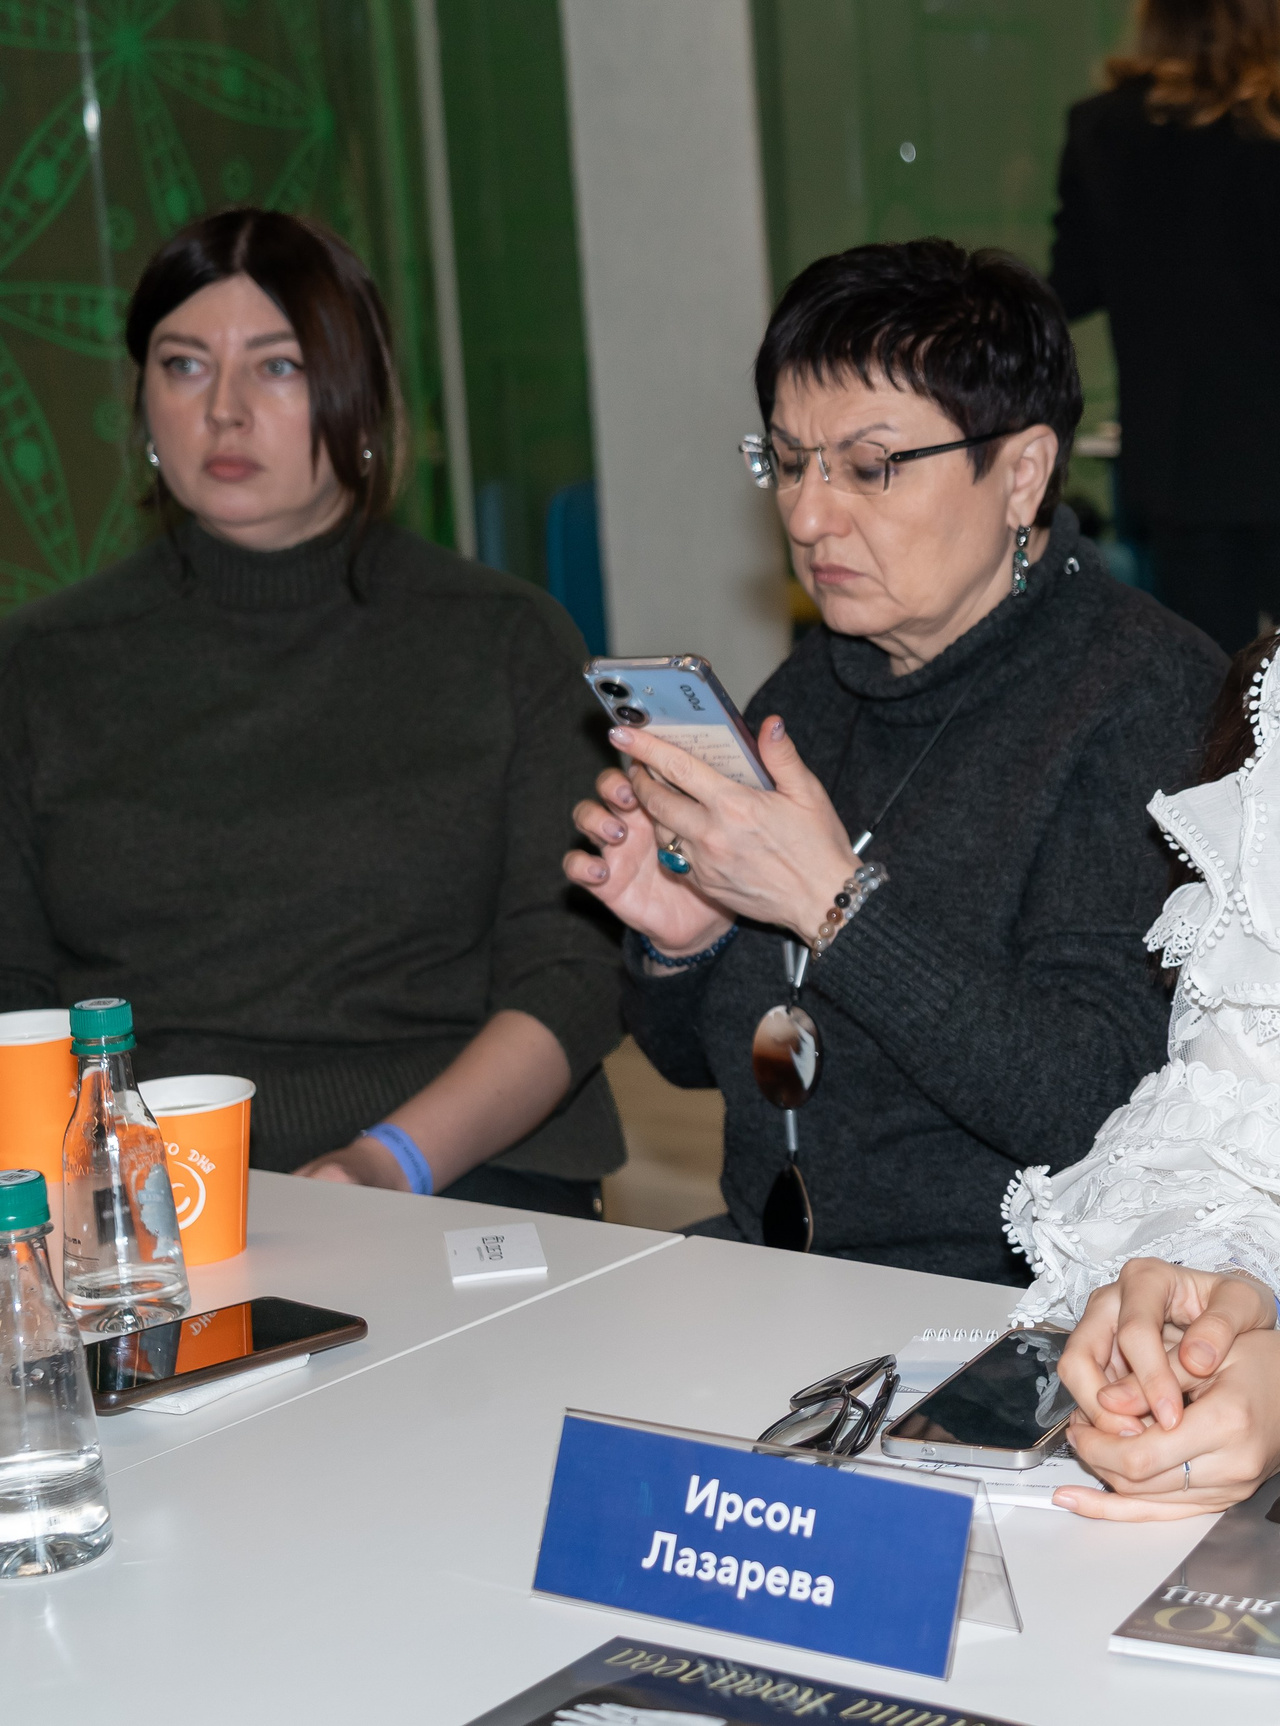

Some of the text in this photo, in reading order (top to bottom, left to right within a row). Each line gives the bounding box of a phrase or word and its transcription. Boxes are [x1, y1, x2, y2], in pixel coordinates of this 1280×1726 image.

[680, 685, 706, 711] POCO
[187, 1148, 216, 1175] ДНЯ
[684, 1474, 817, 1539] Ирсон
[641, 1530, 835, 1607] Лазарева
[605, 1646, 836, 1716] Ковалева
